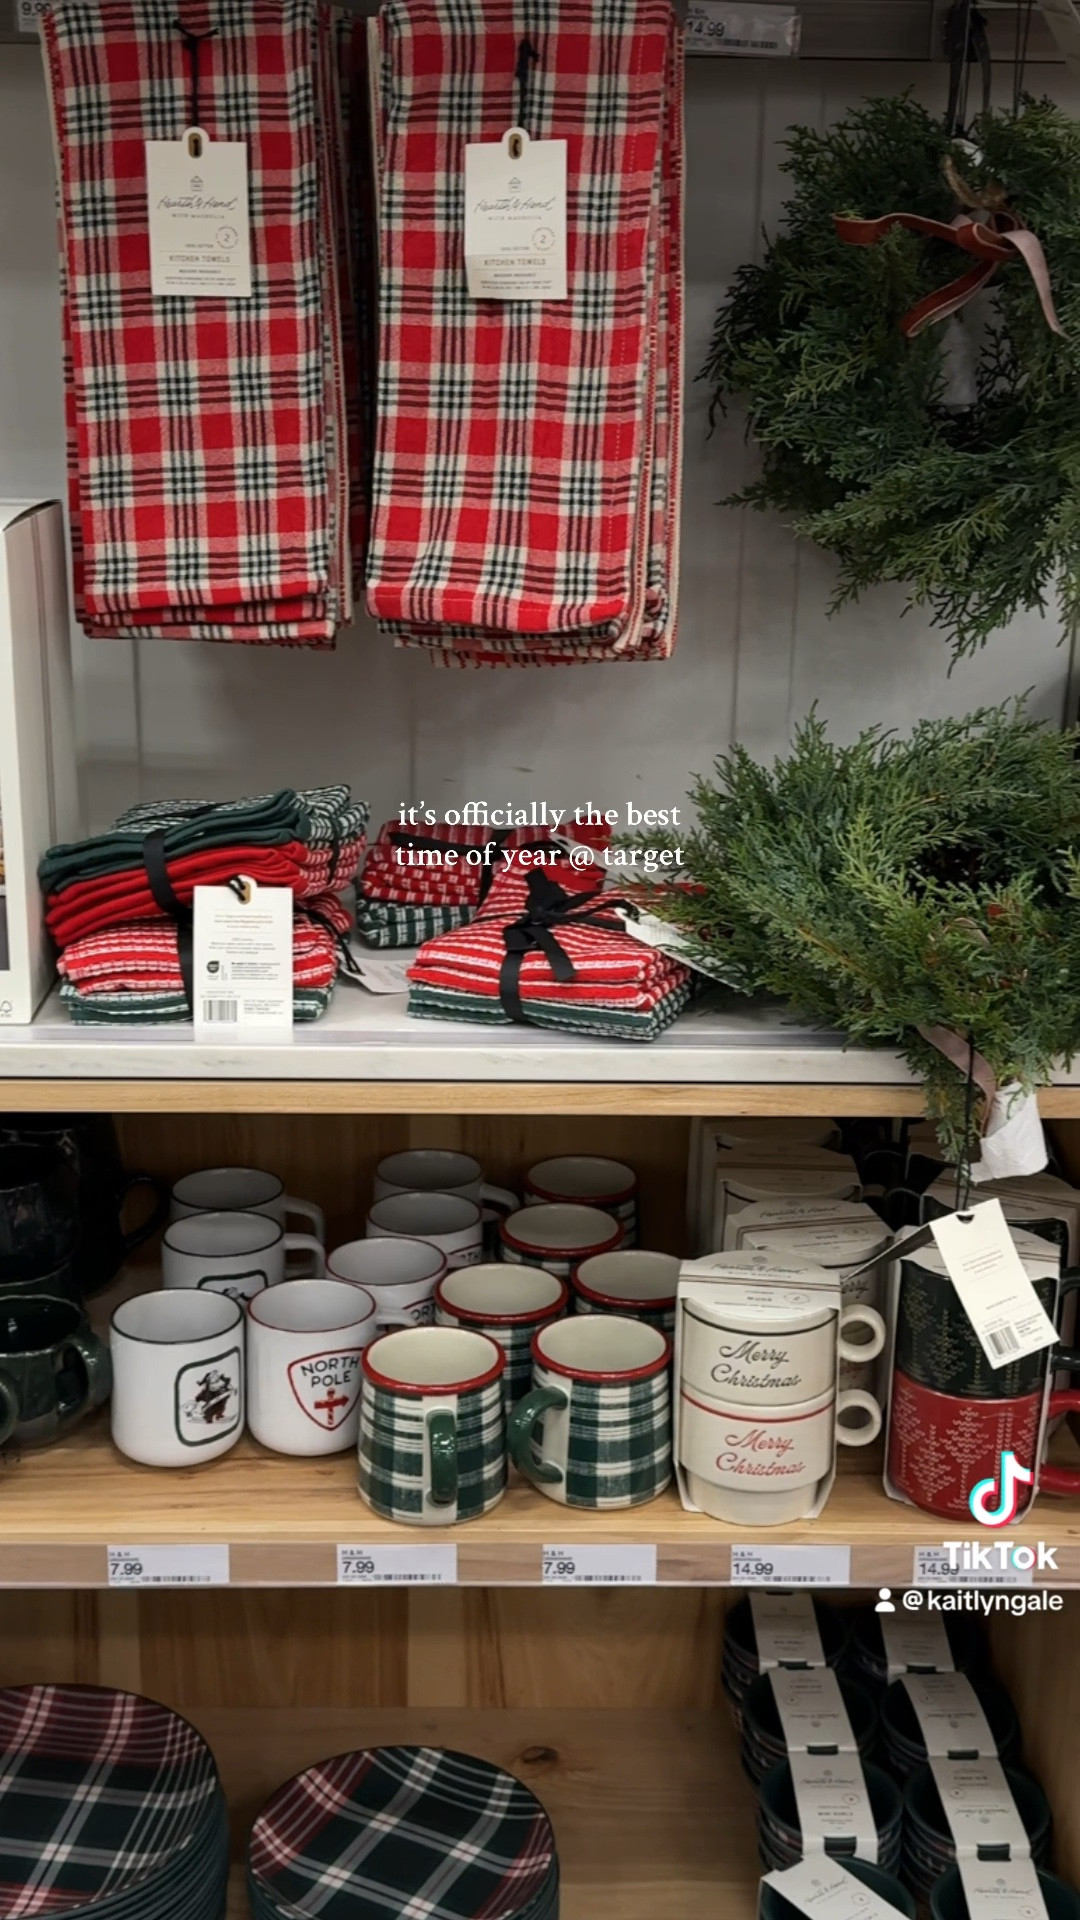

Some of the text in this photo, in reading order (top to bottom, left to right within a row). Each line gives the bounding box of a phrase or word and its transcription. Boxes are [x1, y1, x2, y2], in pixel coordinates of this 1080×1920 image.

[686, 21, 725, 37] 14.99
[719, 1340, 790, 1369] Merry
[301, 1355, 360, 1376] NORTH
[311, 1370, 351, 1388] POLE
[711, 1363, 801, 1388] Christmas
[724, 1429, 794, 1457] Merry
[716, 1452, 806, 1476] Christmas
[110, 1562, 143, 1576] 7.99
[342, 1561, 375, 1574] 7.99
[543, 1561, 576, 1575] 7.99
[733, 1562, 773, 1575] 14.99
